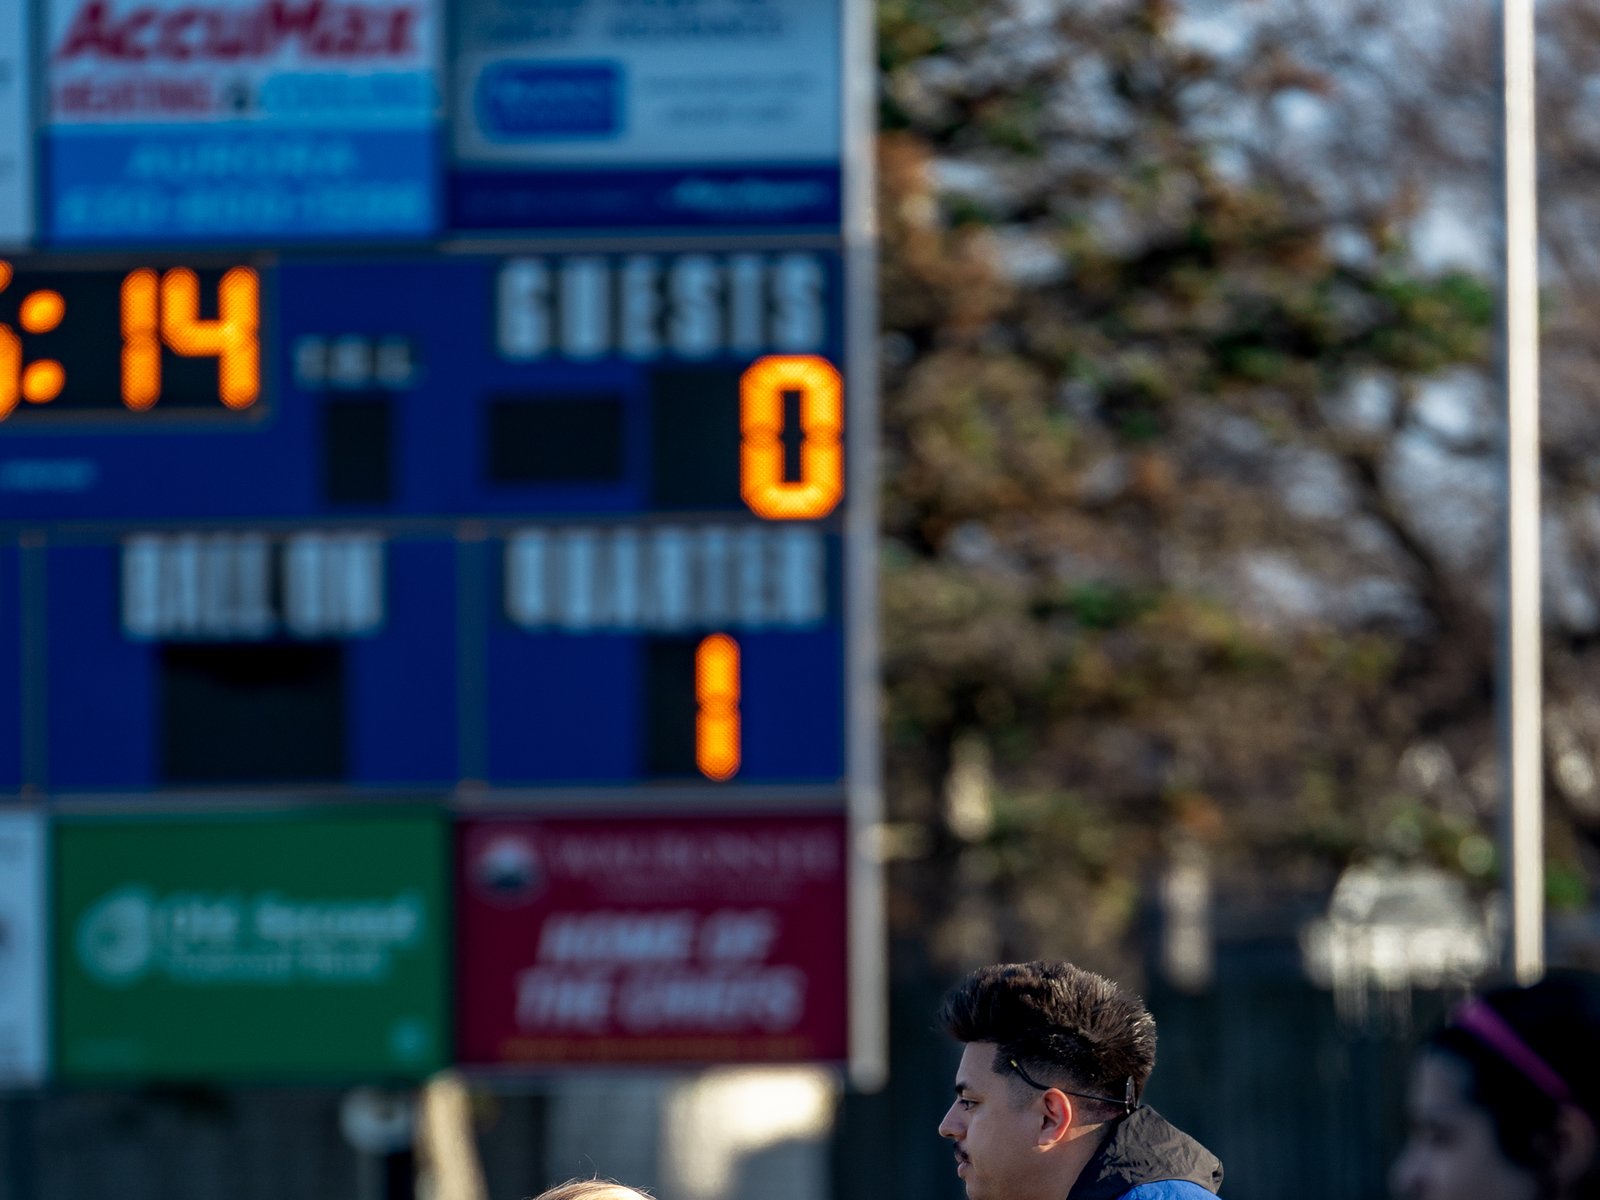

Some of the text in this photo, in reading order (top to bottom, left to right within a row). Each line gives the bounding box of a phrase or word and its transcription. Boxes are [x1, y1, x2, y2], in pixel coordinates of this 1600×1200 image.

[496, 254, 825, 360] GUESTS
[740, 355, 844, 519] 0
[505, 527, 825, 631] QUARTER
[695, 631, 741, 781] 1
[539, 910, 698, 961] HOME
